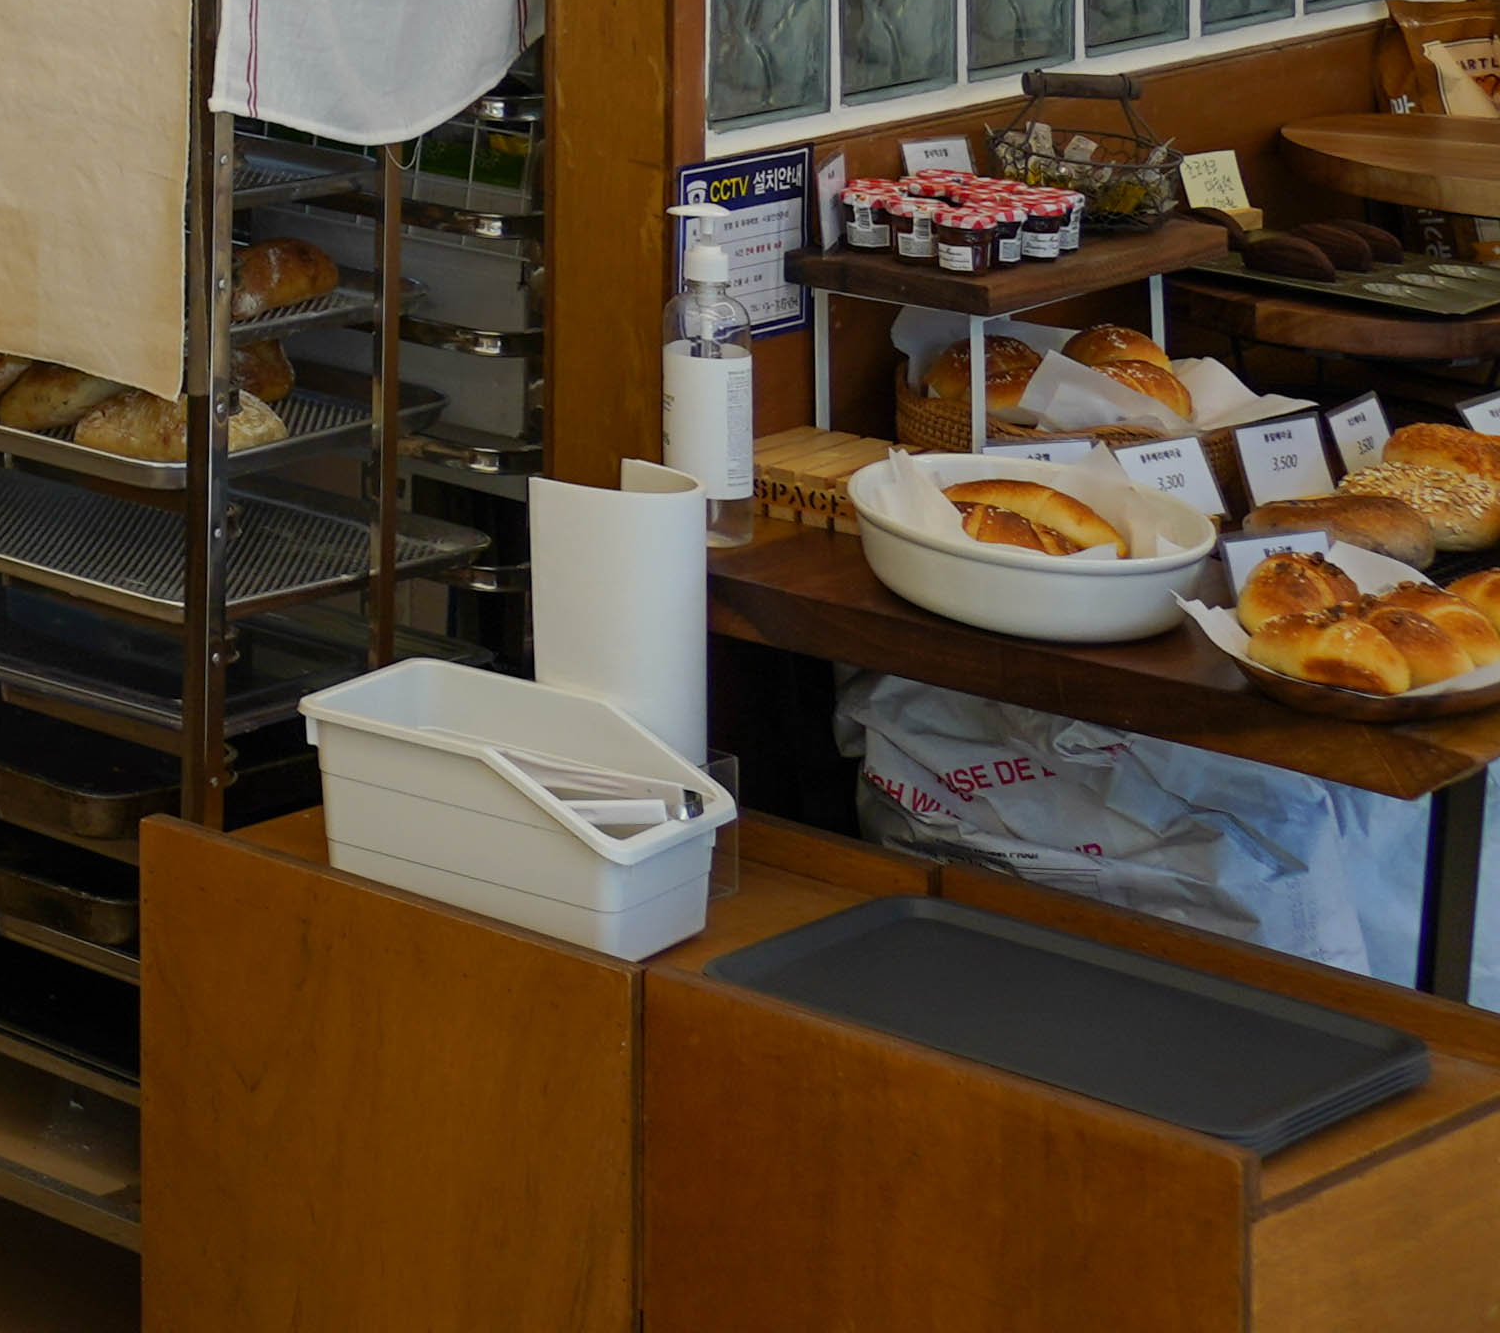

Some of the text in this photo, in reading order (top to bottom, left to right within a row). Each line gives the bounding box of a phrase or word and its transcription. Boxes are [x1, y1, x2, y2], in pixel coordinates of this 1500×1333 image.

[710, 163, 803, 203] CCTV 설치안내
[1272, 454, 1298, 472] 3,500
[1157, 473, 1185, 492] 3,300
[995, 757, 1035, 785] DE
